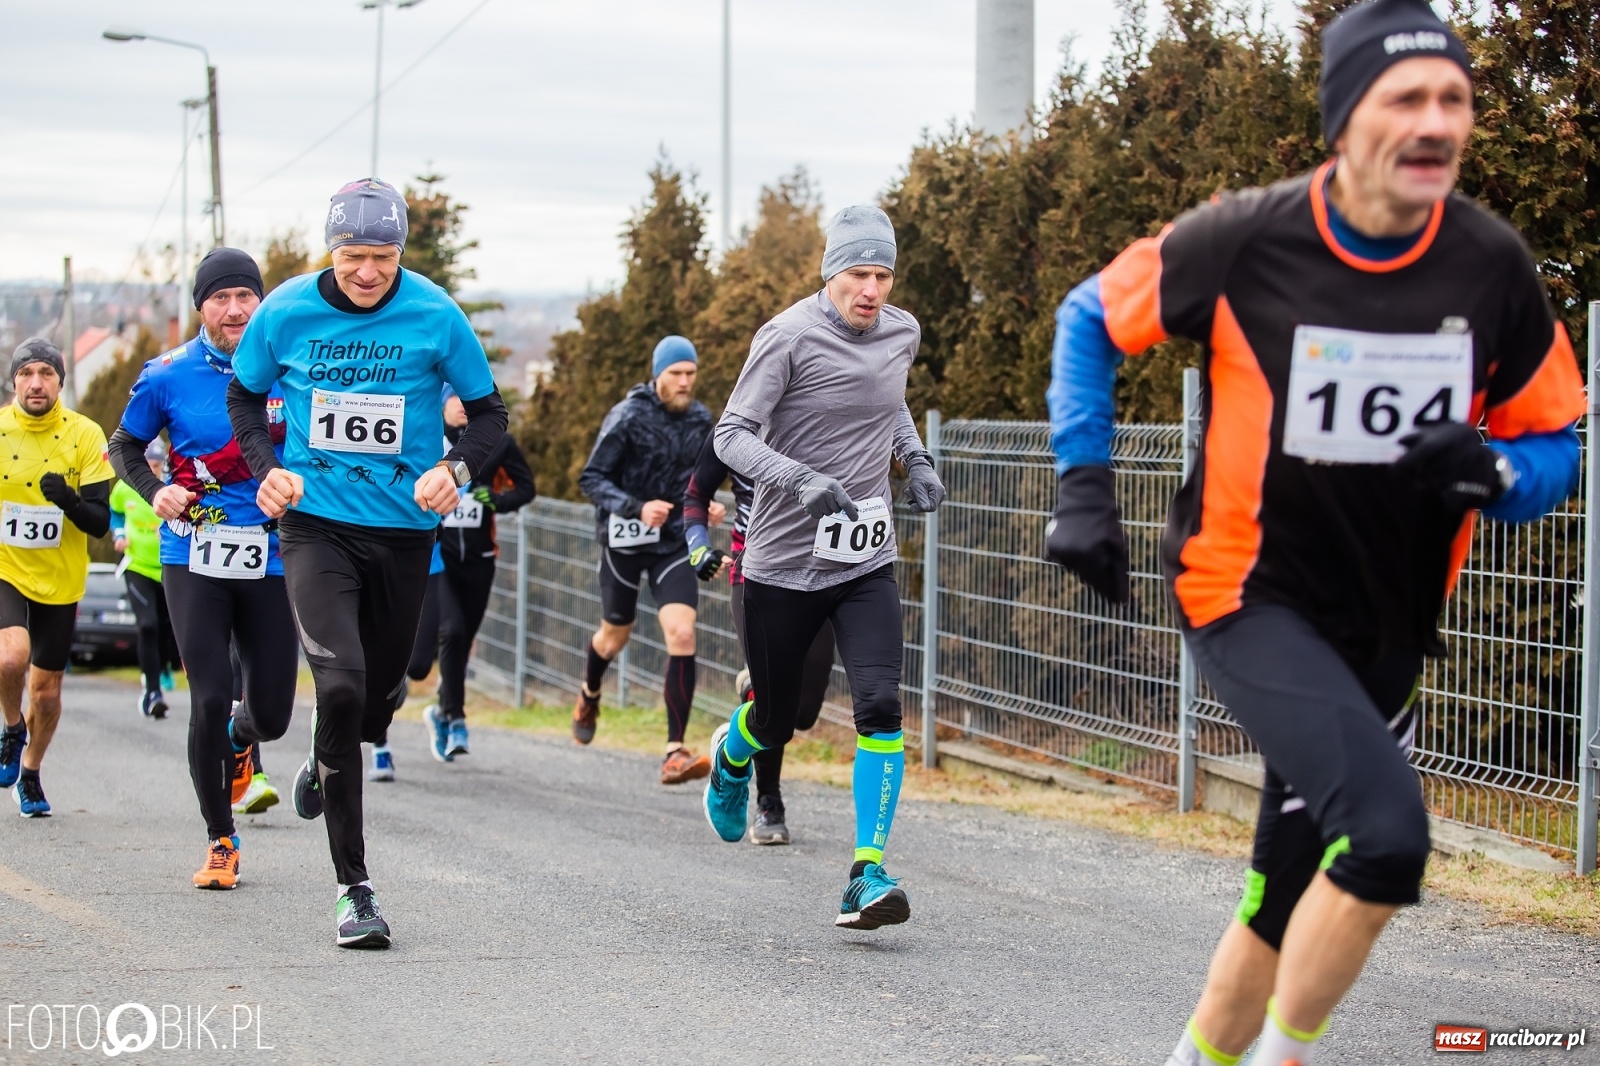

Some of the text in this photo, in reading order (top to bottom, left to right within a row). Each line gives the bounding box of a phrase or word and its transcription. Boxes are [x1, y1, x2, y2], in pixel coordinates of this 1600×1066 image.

[860, 249, 877, 259] 4F
[307, 339, 403, 360] Triathlon
[308, 362, 397, 387] Gogolin
[1308, 381, 1454, 436] 164
[318, 412, 397, 445] 166
[6, 518, 59, 541] 130
[614, 522, 656, 539] 292
[824, 520, 887, 552] 108
[196, 540, 263, 570] 173
